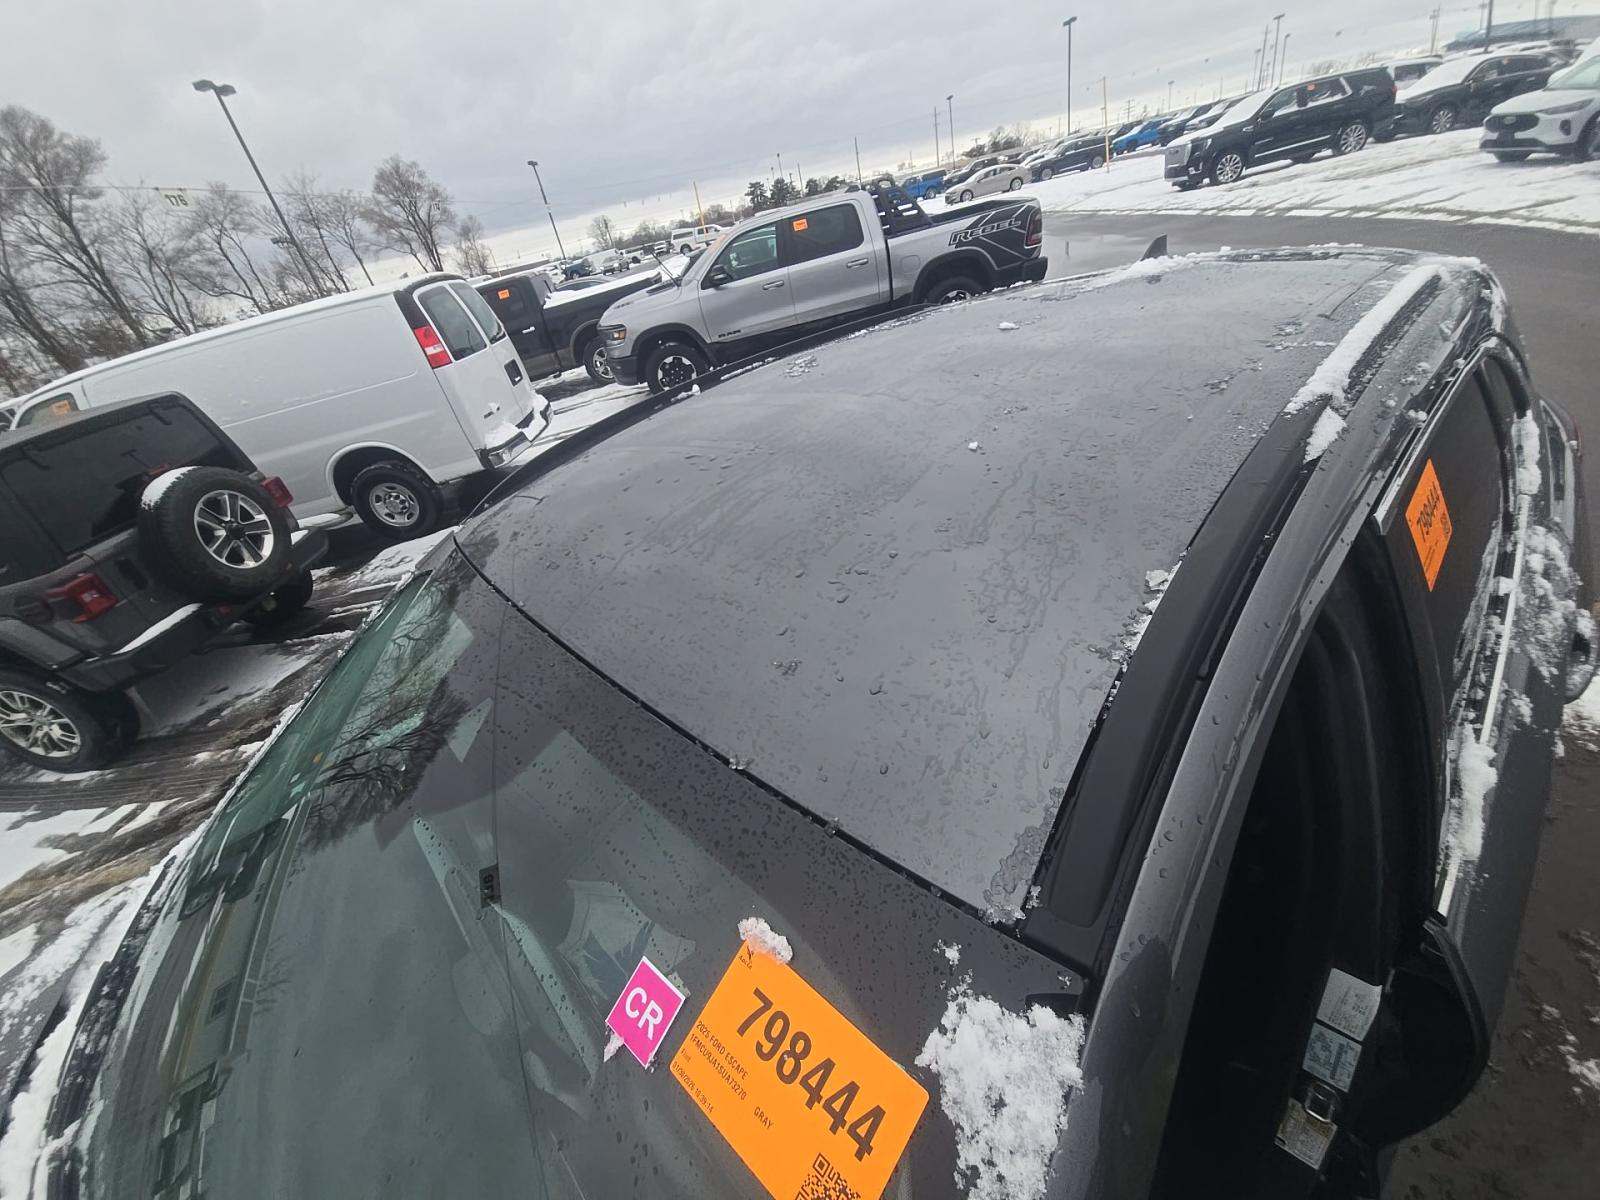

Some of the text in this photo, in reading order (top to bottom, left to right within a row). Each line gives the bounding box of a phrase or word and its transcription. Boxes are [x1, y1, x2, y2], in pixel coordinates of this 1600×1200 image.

[949, 218, 1021, 247] REBEL
[625, 987, 663, 1040] CR
[709, 1036, 726, 1055] FORD
[725, 1052, 748, 1080] ESCAPE
[736, 987, 886, 1162] 798444
[753, 1106, 774, 1131] GRAY
